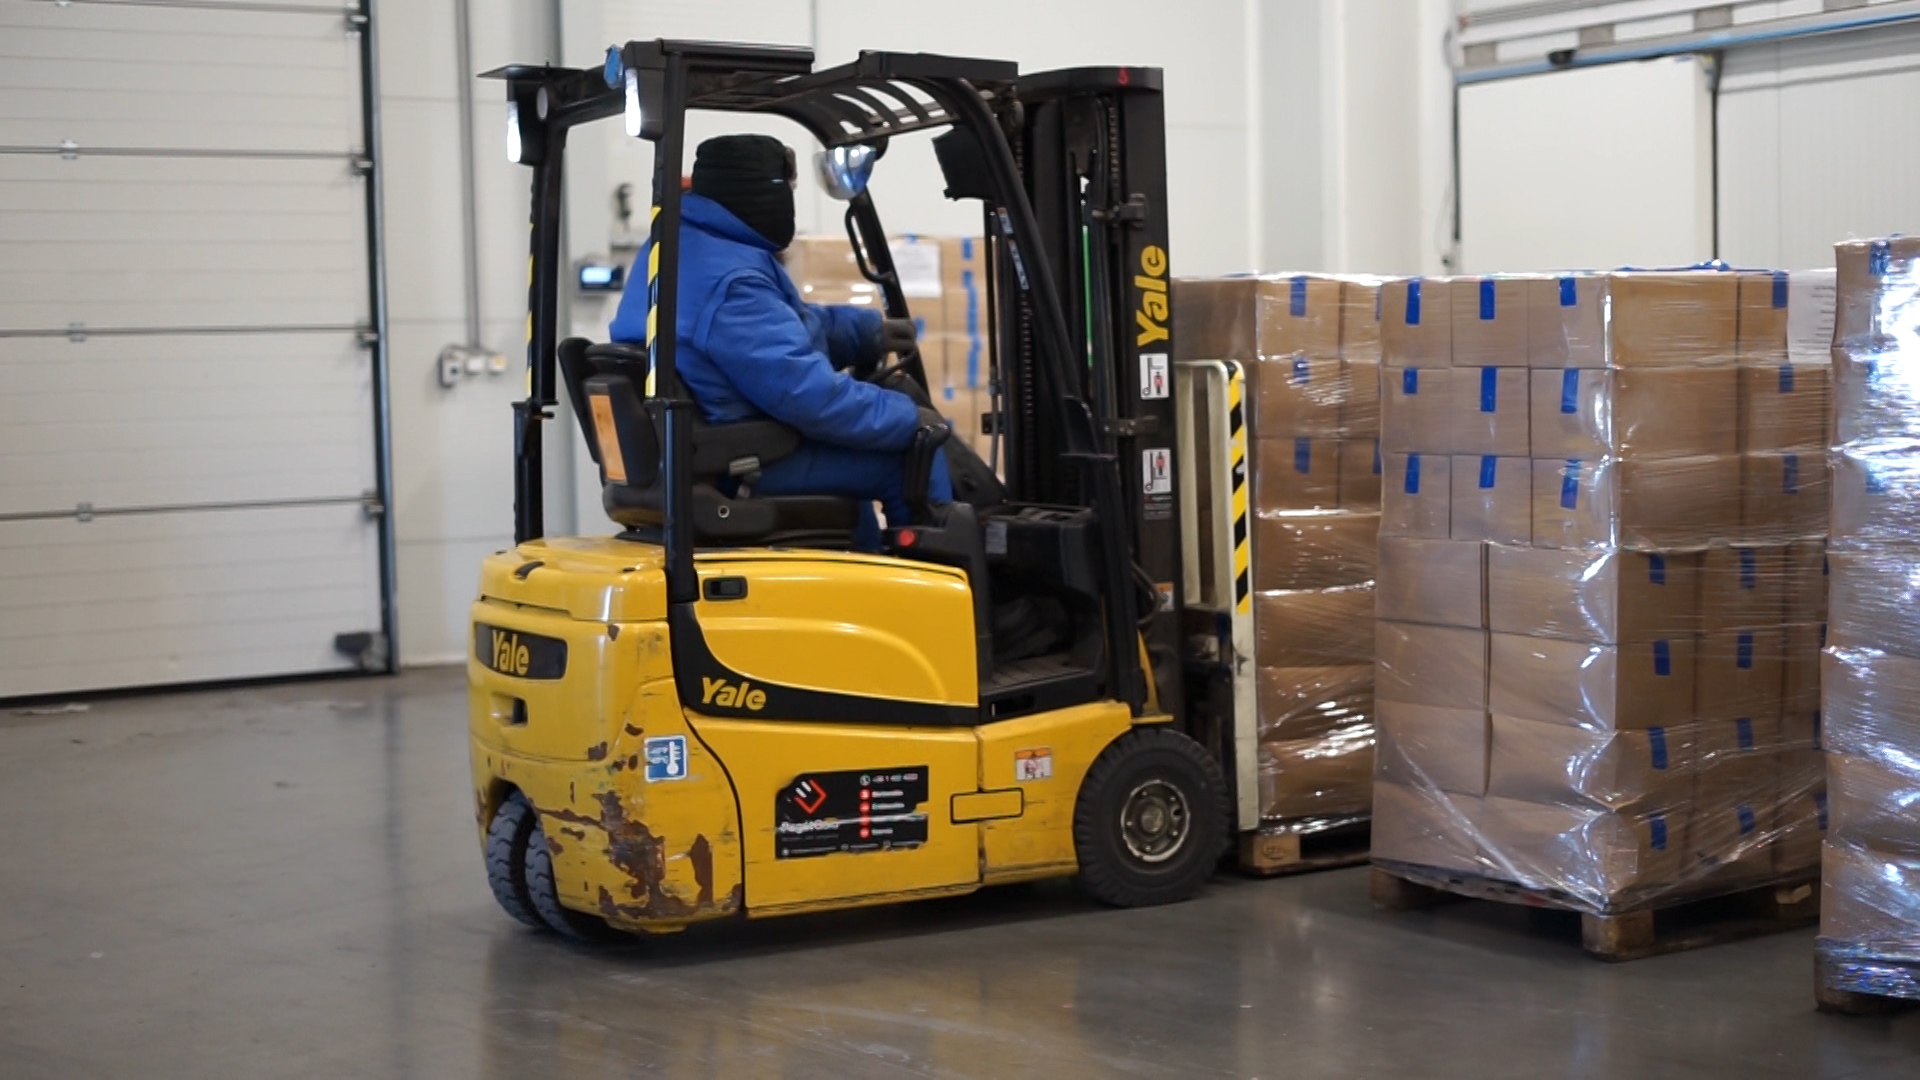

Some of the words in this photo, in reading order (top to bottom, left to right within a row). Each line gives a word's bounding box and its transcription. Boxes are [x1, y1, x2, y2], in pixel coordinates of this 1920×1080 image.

[1134, 244, 1170, 347] Yale
[491, 629, 530, 676] Yale
[701, 676, 767, 712] Yale
